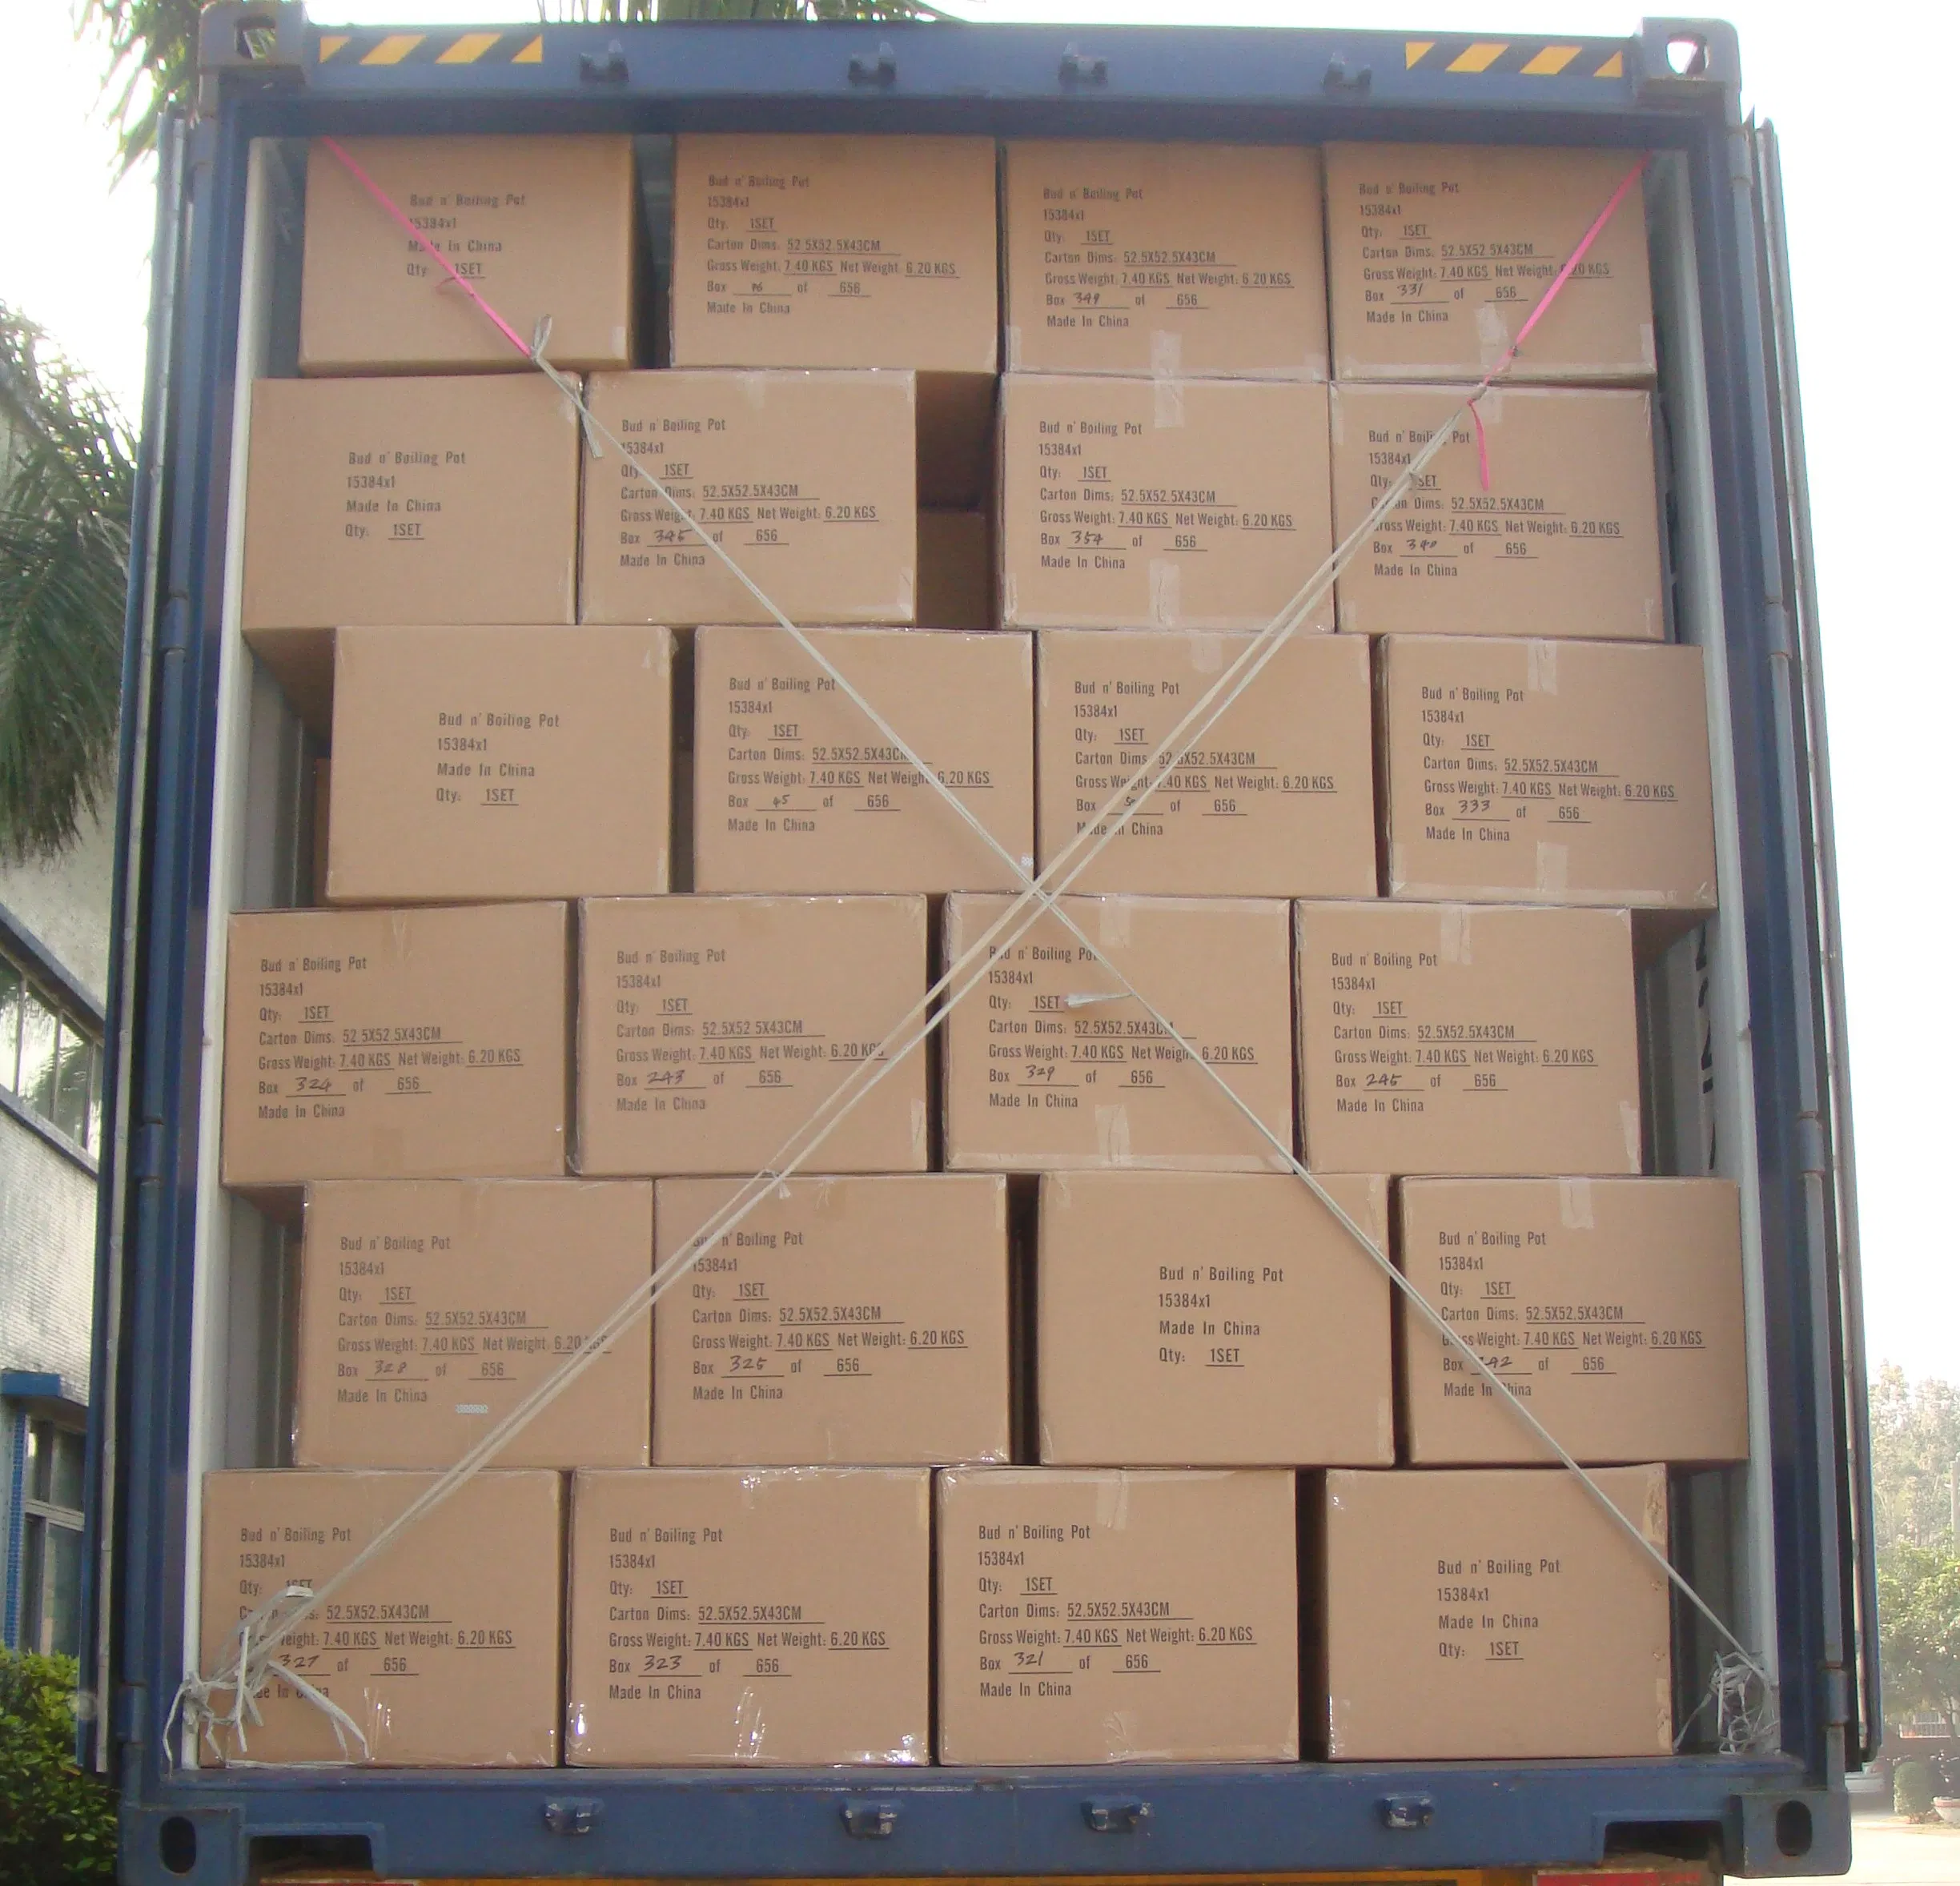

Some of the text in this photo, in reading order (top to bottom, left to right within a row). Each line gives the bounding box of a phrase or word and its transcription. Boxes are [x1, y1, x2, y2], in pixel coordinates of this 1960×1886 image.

[1364, 289, 1384, 302] Box
[1453, 287, 1464, 300] of
[1495, 286, 1517, 299] 656
[1046, 314, 1129, 327] Made In China
[1039, 420, 1060, 434] Bud
[1080, 421, 1119, 437] Boiling
[1124, 422, 1143, 435] Pot
[1038, 443, 1082, 456] 15384x1
[348, 451, 372, 465] Bud
[395, 451, 439, 467] Boiling
[445, 451, 466, 464] Pot
[1039, 465, 1107, 481] Qty: 1SET
[347, 475, 396, 489] 15384x1
[1040, 487, 1215, 504] Carton Dims: 52.5X52.5X43CM
[346, 499, 441, 513] Made In China
[1040, 509, 1292, 530] Gross Weight: 7.40 KGS Net Weight: 6.20 KGS
[393, 523, 422, 536] 1SET
[1040, 532, 1060, 546] Box
[1132, 534, 1143, 548] of
[1175, 534, 1196, 548] 656
[1041, 555, 1126, 569] Made In China
[1421, 686, 1443, 700] Bud
[1462, 687, 1500, 704] Boiling
[1506, 688, 1524, 702] Pot
[439, 712, 463, 726] Bud
[486, 712, 532, 729] Boiling
[539, 713, 560, 728] Pot
[1421, 709, 1464, 724] 15384x1
[438, 736, 487, 752] 15384x1
[437, 762, 535, 777] Made In China
[436, 787, 515, 805] Qty: 1SET
[1424, 799, 1580, 820] Box 333 of 656
[1426, 825, 1510, 841] Made In China
[1331, 952, 1352, 967] Bud
[1373, 952, 1413, 969] Boiling
[1419, 953, 1437, 967] Pot
[1331, 976, 1376, 991] 15384x1
[1333, 1001, 1404, 1017] Qty: 1SET
[1334, 1024, 1515, 1040] Carton Dims: 52.5X52.5X43CM
[1335, 1049, 1594, 1066] Gross Weight: 7.40 KGS Net Weight: 6.20 KGS
[259, 1081, 279, 1095] Box
[352, 1077, 364, 1093] of
[397, 1076, 420, 1091] 656
[1335, 1073, 1356, 1088] Box
[1430, 1073, 1441, 1088] of
[1474, 1073, 1496, 1088] 656
[616, 1096, 706, 1112] Made In China
[1336, 1097, 1424, 1113] Made In China
[1439, 1256, 1484, 1271] 15384x1
[1159, 1266, 1184, 1281] Bud
[1209, 1266, 1255, 1285] Boiling
[1263, 1267, 1283, 1282] Pot
[1159, 1293, 1211, 1308] 15384x1
[1159, 1320, 1260, 1336] Made In China
[1159, 1346, 1240, 1365] Qty: 1SET
[693, 1360, 714, 1374] Box
[790, 1358, 802, 1374] of
[837, 1357, 860, 1373] 656
[978, 1525, 1001, 1540] Bud
[1022, 1524, 1065, 1543] Boiling
[1071, 1524, 1090, 1539] Pot
[978, 1551, 1024, 1567] 15384x1
[1437, 1559, 1462, 1575] Bud
[1487, 1559, 1532, 1577] Boiling
[1540, 1559, 1560, 1573] Pot
[978, 1576, 1053, 1595] Qty: 1SET
[1437, 1587, 1489, 1602] 15384x1
[979, 1601, 1170, 1619] Carton Dims: 52.5X52.5X43CM
[1438, 1613, 1539, 1630] Made In China
[979, 1626, 1253, 1647] Gross Weight: 7.40 KGS Net Weight: 6.20 KGS
[1439, 1641, 1520, 1659] Qty: 1SET
[608, 1655, 779, 1674] Box 323 of 656
[979, 1650, 1148, 1671] Box 321 of 656
[980, 1681, 1071, 1697] Made In China
